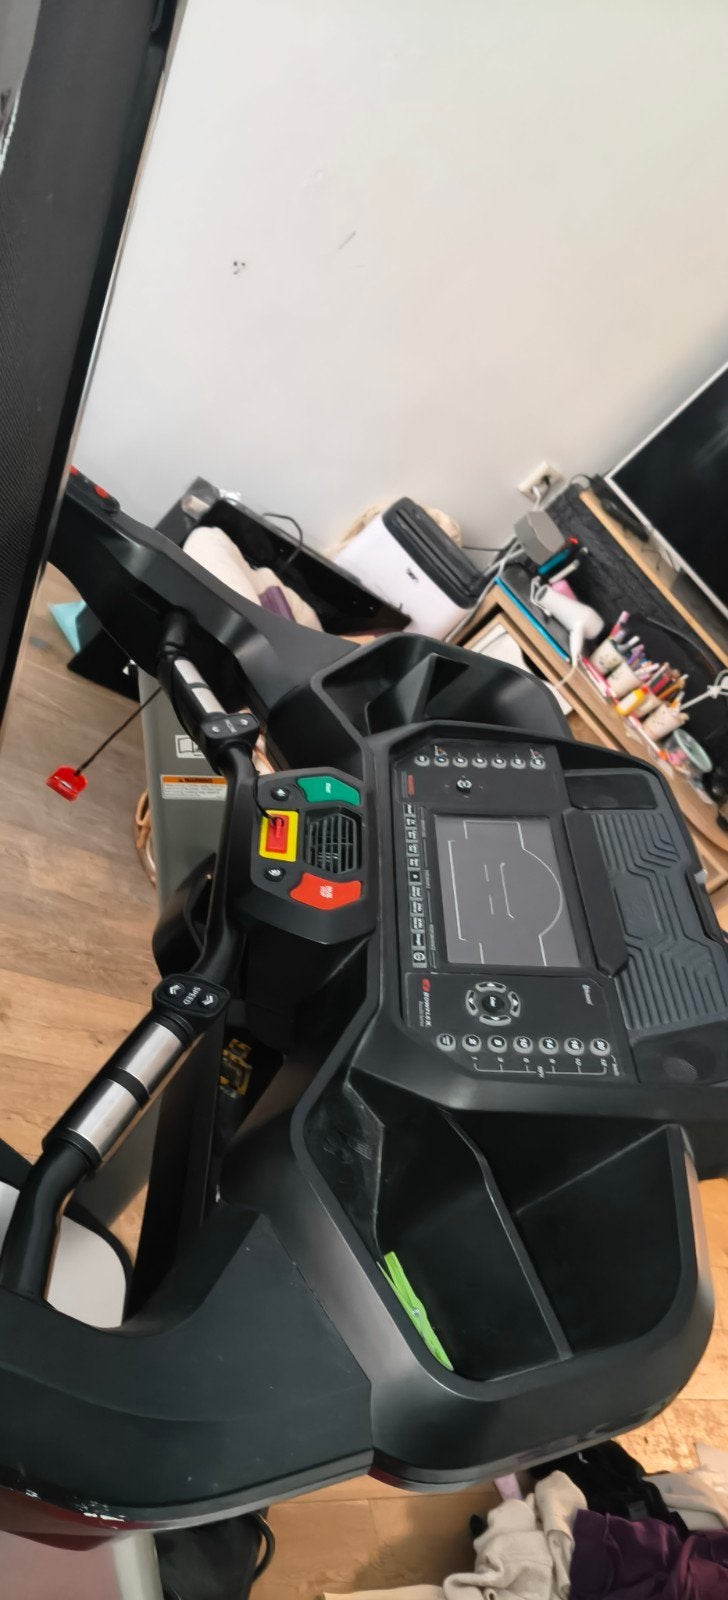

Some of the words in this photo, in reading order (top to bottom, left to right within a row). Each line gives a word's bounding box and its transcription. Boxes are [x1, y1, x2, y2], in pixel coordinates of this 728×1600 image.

[183, 986, 201, 1005] SPEED
[423, 992, 432, 1027] BOWFLEX
[519, 1038, 529, 1049] 10
